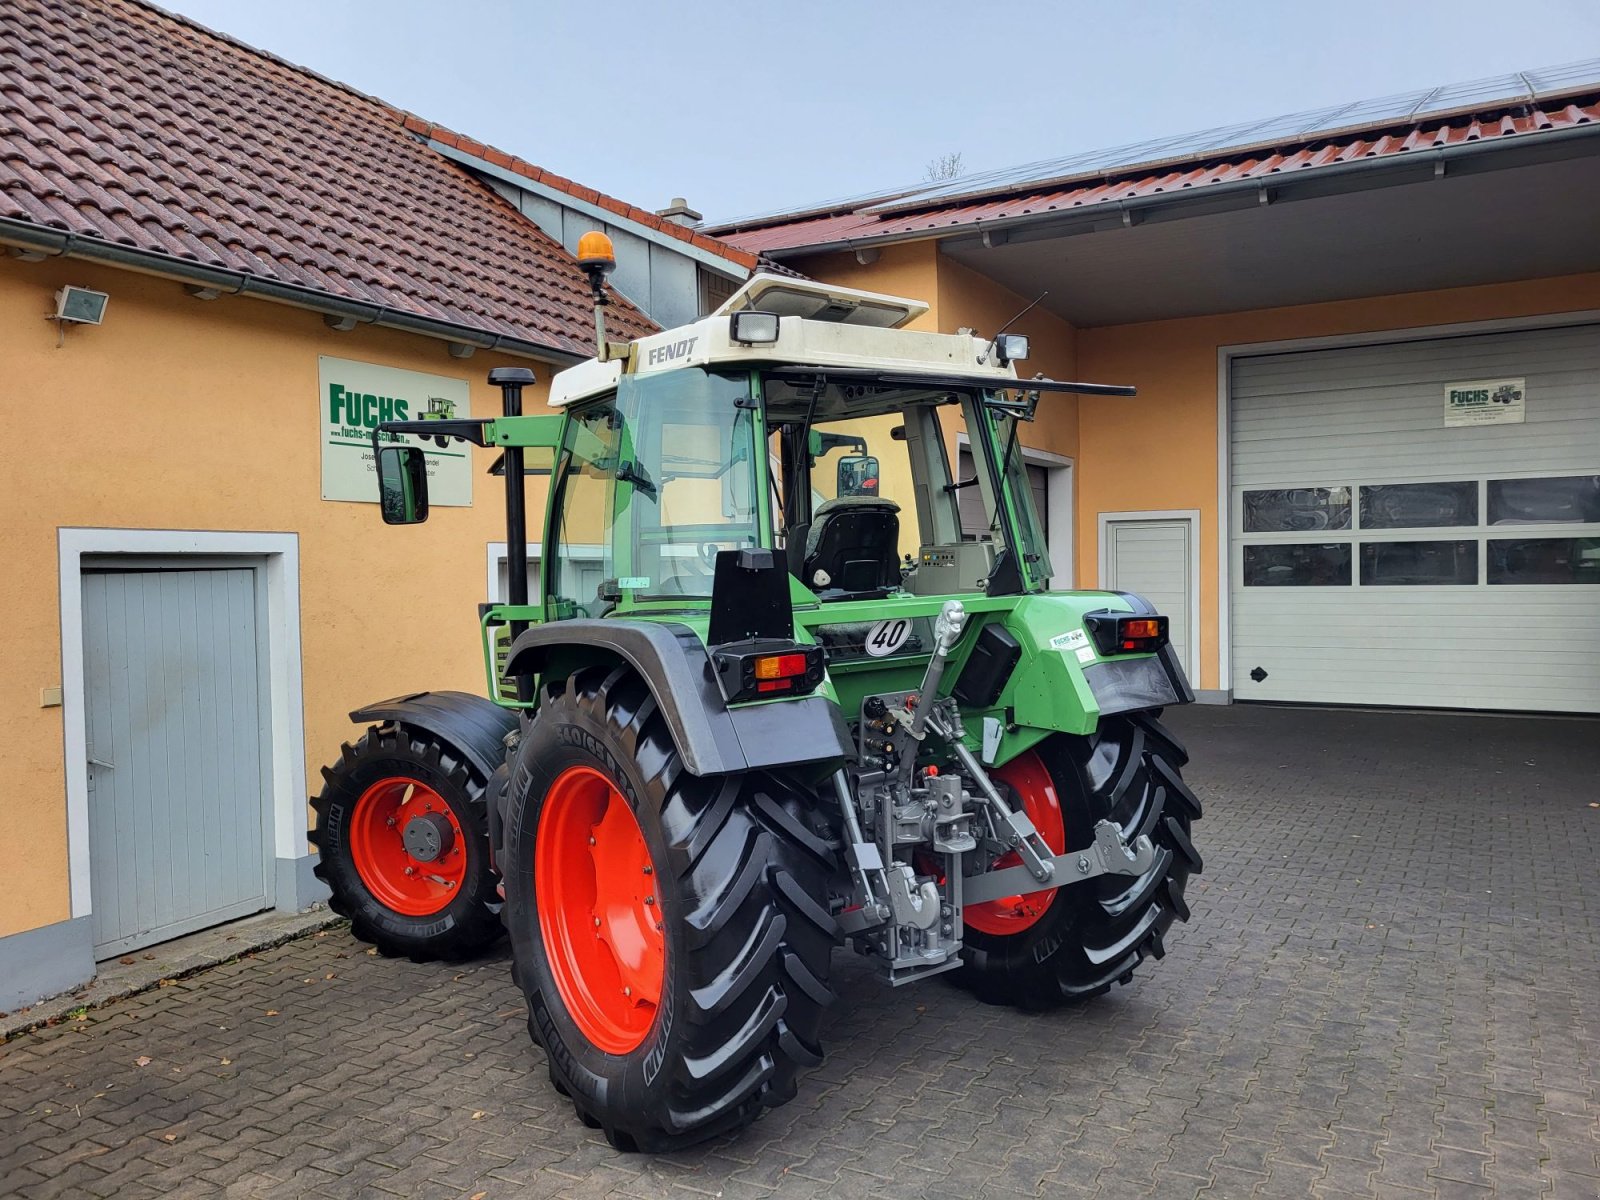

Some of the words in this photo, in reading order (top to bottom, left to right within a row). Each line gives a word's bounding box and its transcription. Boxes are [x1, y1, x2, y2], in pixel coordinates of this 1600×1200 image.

[649, 336, 699, 366] FENDT
[329, 383, 409, 428] FUCHS
[1450, 389, 1489, 404] FUCHS
[872, 620, 907, 649] 40
